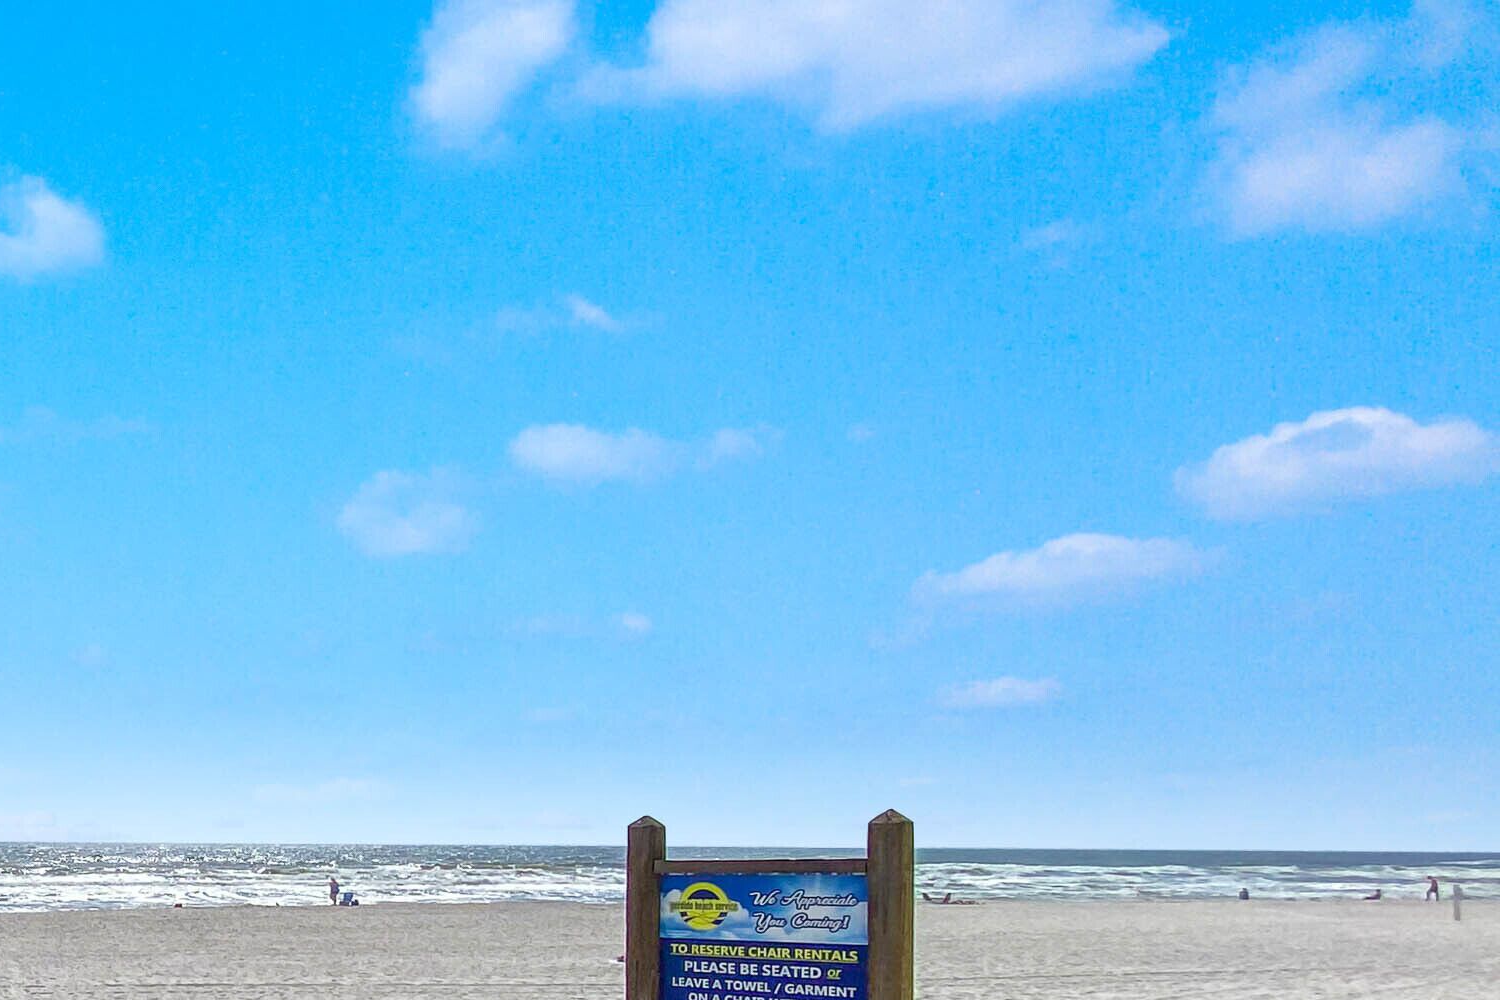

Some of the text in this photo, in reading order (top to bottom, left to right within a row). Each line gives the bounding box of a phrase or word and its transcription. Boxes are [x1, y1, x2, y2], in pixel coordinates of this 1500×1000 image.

[750, 890, 858, 910] We Appreciate
[752, 912, 850, 932] You Coming!
[671, 943, 859, 962] TO RESERVE CHAIR RENTALS
[684, 961, 842, 979] PLEASE BE SEATED or
[672, 977, 856, 998] LEAVE A TOWEL / GARMENT
